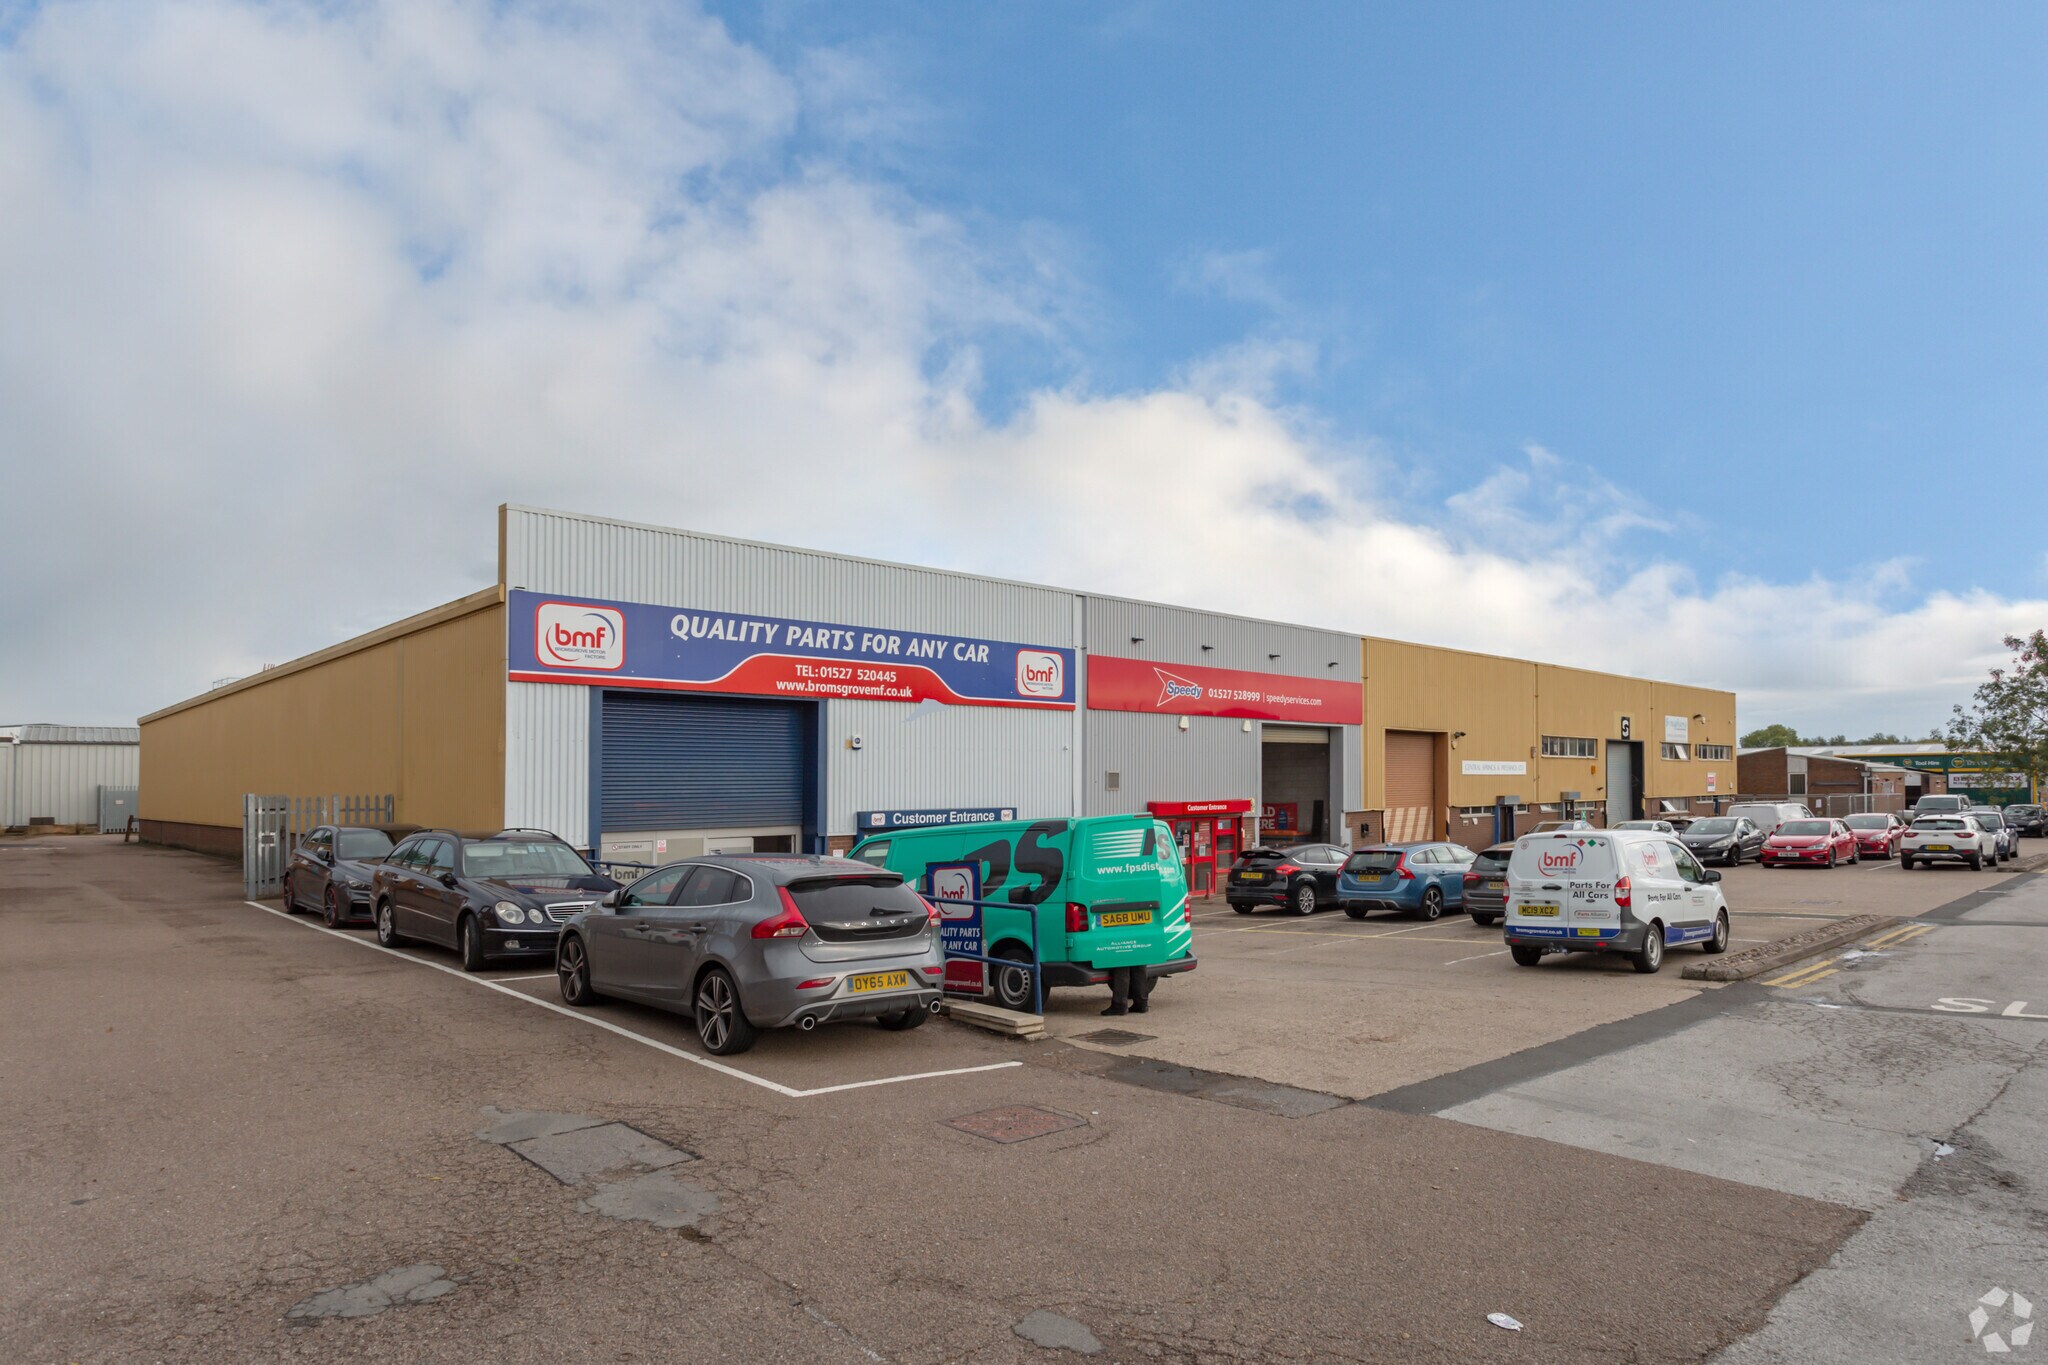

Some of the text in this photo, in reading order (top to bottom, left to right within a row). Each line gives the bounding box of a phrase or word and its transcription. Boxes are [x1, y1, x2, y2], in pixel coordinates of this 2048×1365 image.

[555, 622, 606, 649] bmf
[670, 614, 990, 663] QUALITY PARTS FOR ANY CAR
[795, 664, 897, 683] TEL: 01527 520445
[1026, 664, 1054, 682] bmf
[776, 680, 912, 698] www.bromsgrovemf.co.uk
[1167, 680, 1203, 699] Speedy
[1208, 688, 1322, 707] 01527 528999 speedyservices.com
[893, 811, 995, 824] Customer Entrance
[1543, 851, 1577, 867] bmf
[1642, 850, 1658, 866] bmf
[614, 868, 640, 880] bmf
[1569, 881, 1611, 889] Parts For
[1572, 891, 1609, 899] All Cars
[1647, 894, 1659, 902] Parts
[1659, 893, 1667, 901] For
[1673, 892, 1682, 900] Cars
[1522, 906, 1554, 915] MC19 XCZ
[844, 918, 909, 928] VOLVO
[1102, 913, 1129, 924] SA68
[940, 927, 958, 937] ALITY
[959, 927, 981, 938] PARTS
[948, 941, 962, 951] ANY
[963, 941, 978, 951] CAR
[886, 973, 907, 987] AXM
